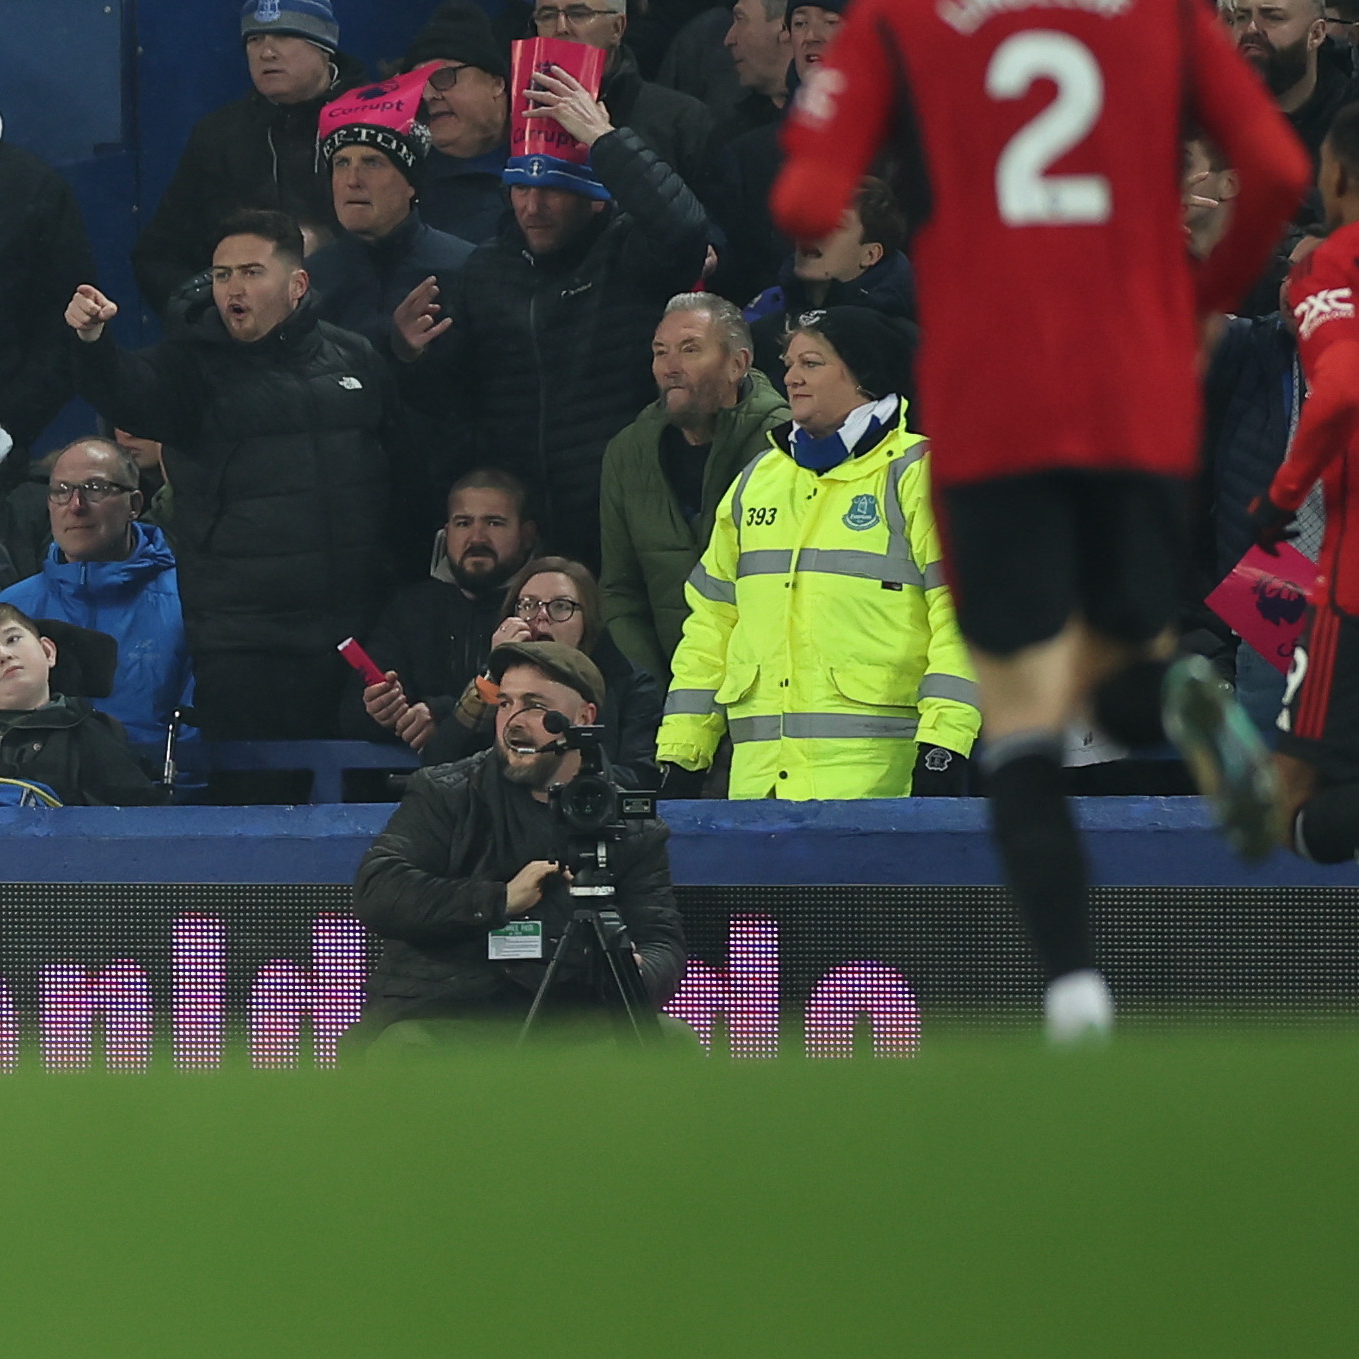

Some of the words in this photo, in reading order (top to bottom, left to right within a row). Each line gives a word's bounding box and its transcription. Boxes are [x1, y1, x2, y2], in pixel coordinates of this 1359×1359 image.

[328, 99, 405, 118] Corrupt
[983, 27, 1113, 228] 2
[746, 507, 778, 526] 393
